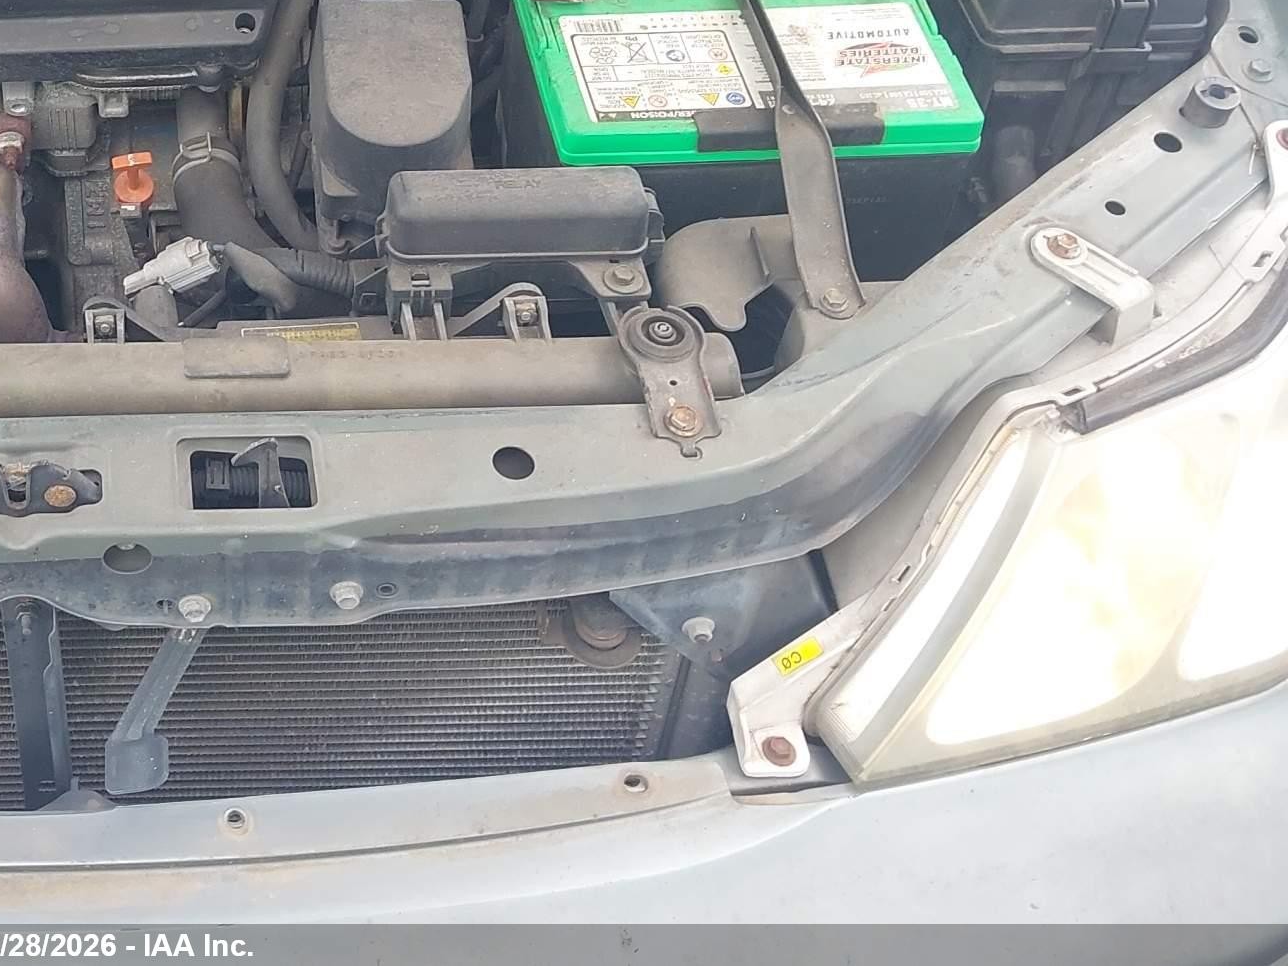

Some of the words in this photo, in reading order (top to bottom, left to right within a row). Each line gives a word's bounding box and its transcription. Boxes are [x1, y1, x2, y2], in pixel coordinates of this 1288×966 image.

[827, 28, 911, 40] AUTOMOTIVE
[839, 46, 920, 57] BATTERIES
[836, 54, 927, 67] INTERSTATE
